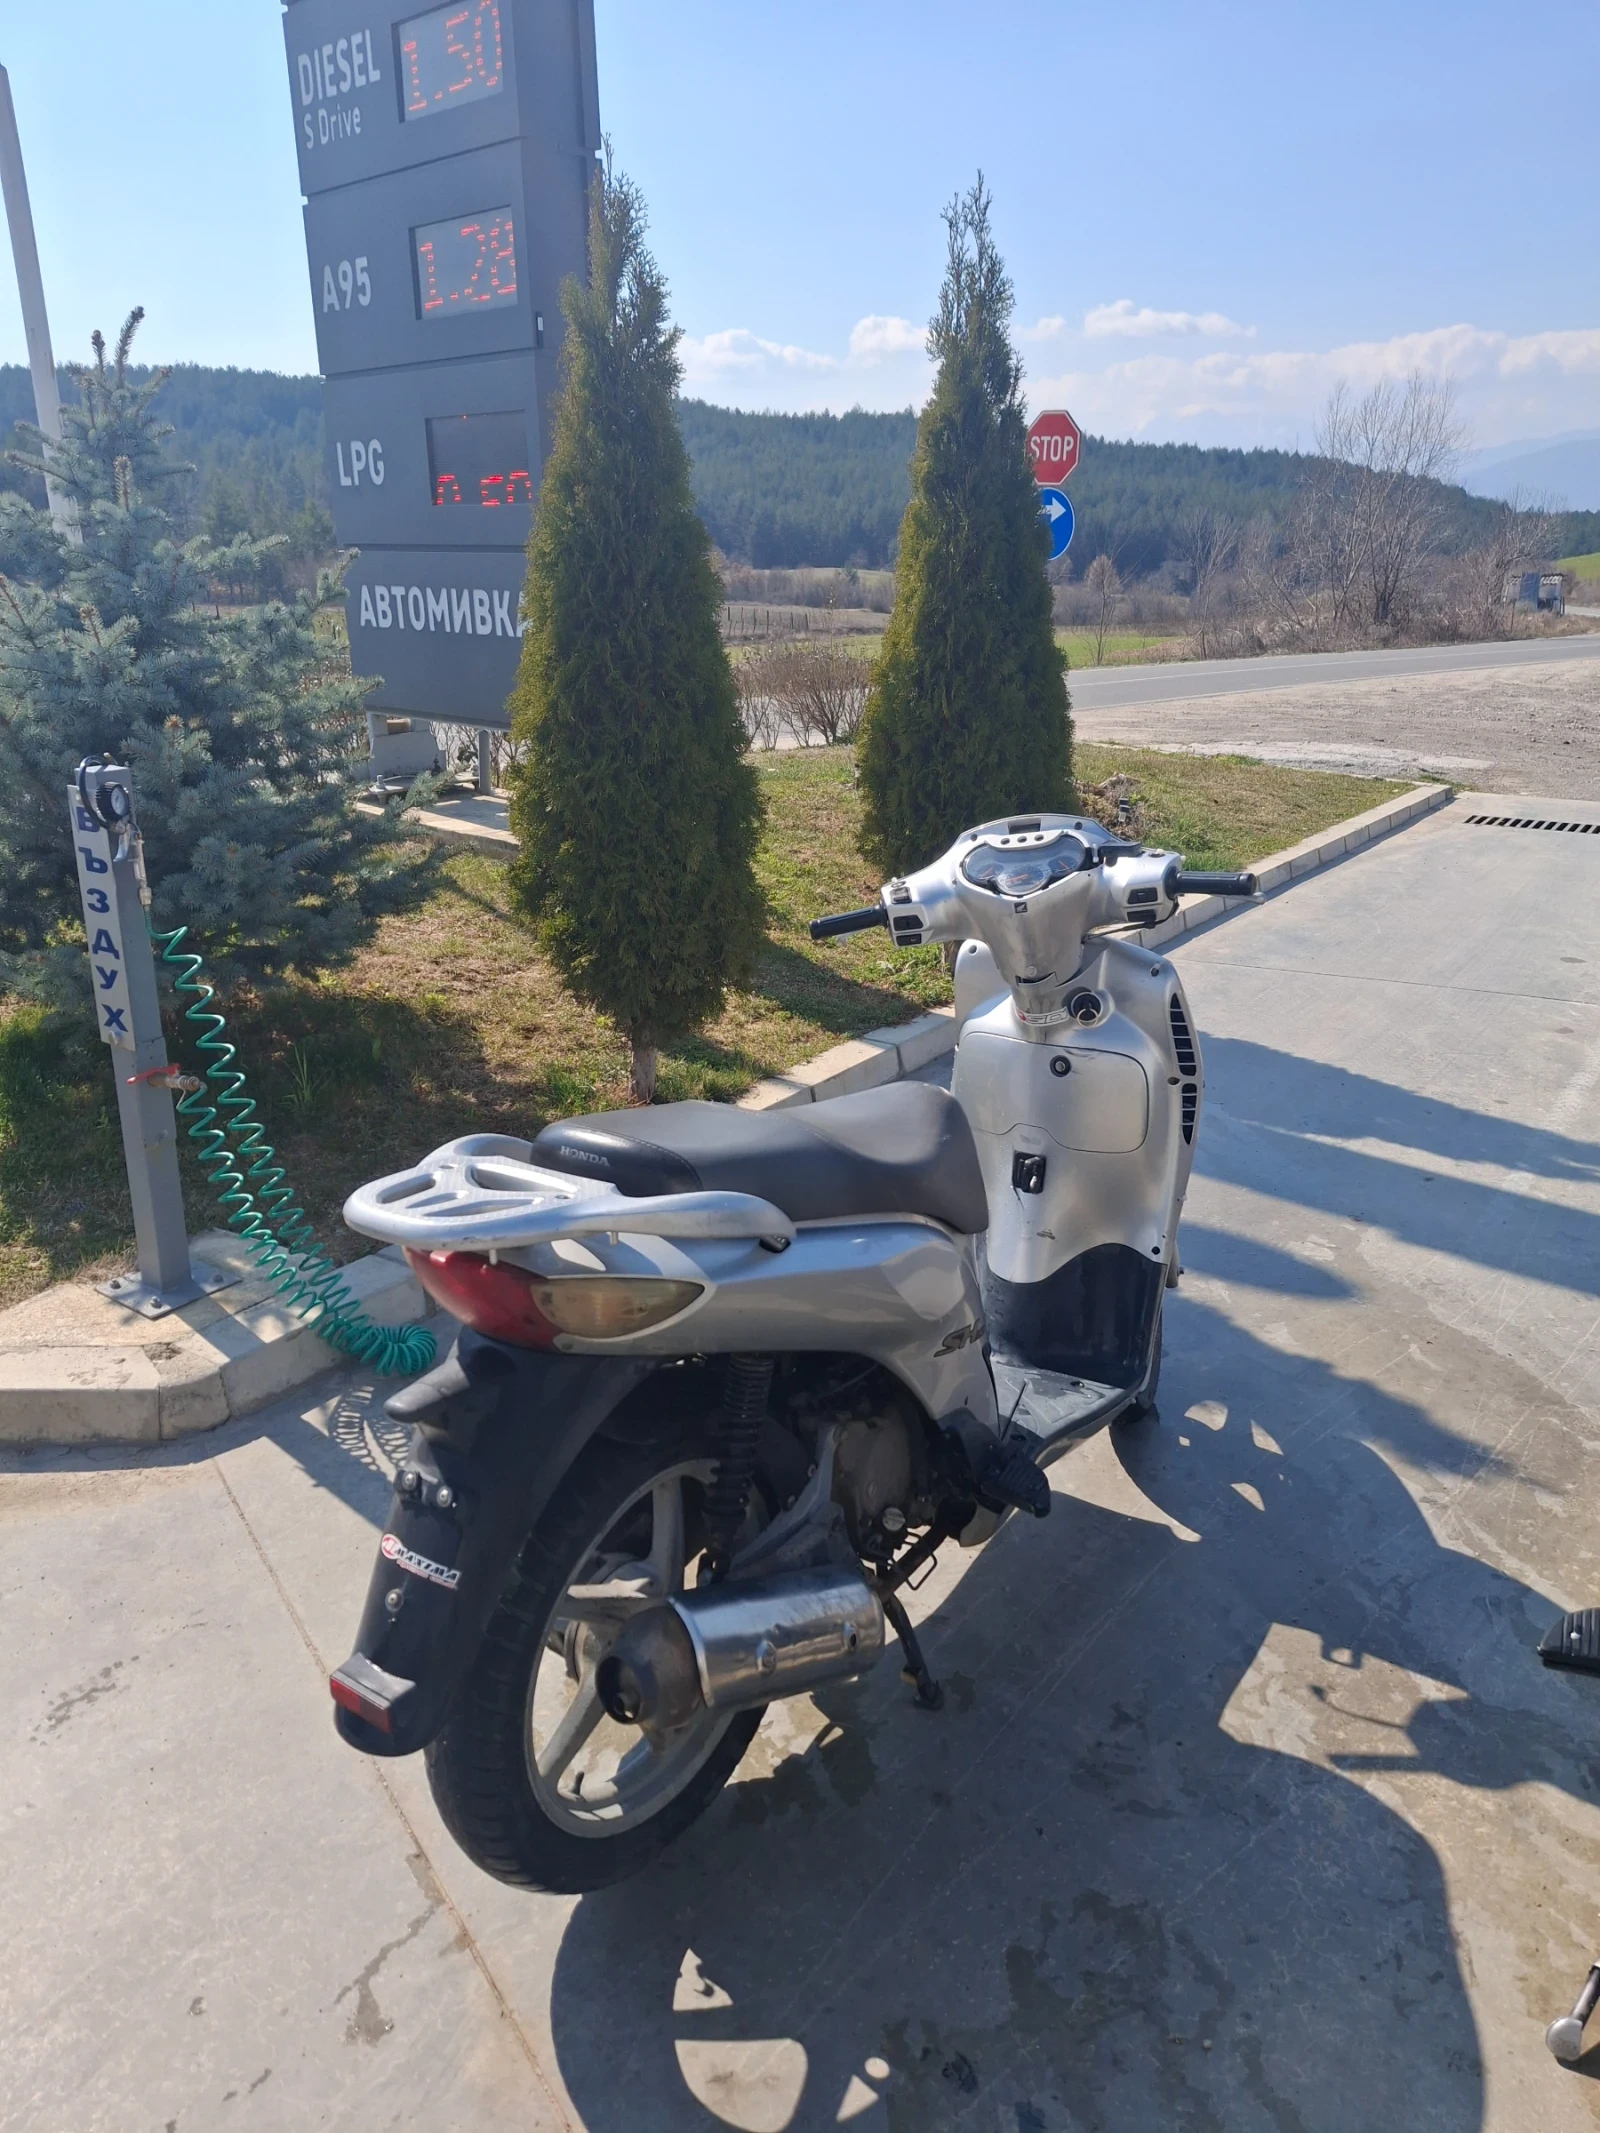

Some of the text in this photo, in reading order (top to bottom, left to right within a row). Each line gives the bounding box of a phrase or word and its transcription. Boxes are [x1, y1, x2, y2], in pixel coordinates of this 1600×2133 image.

[298, 29, 381, 106] DIESEL
[303, 105, 362, 149] S Drive
[322, 256, 371, 313] A95
[336, 438, 385, 487] LPG
[1030, 435, 1074, 462] STOP
[76, 806, 128, 1033] ВЪЗДУХ
[560, 1145, 611, 1167] HONDA
